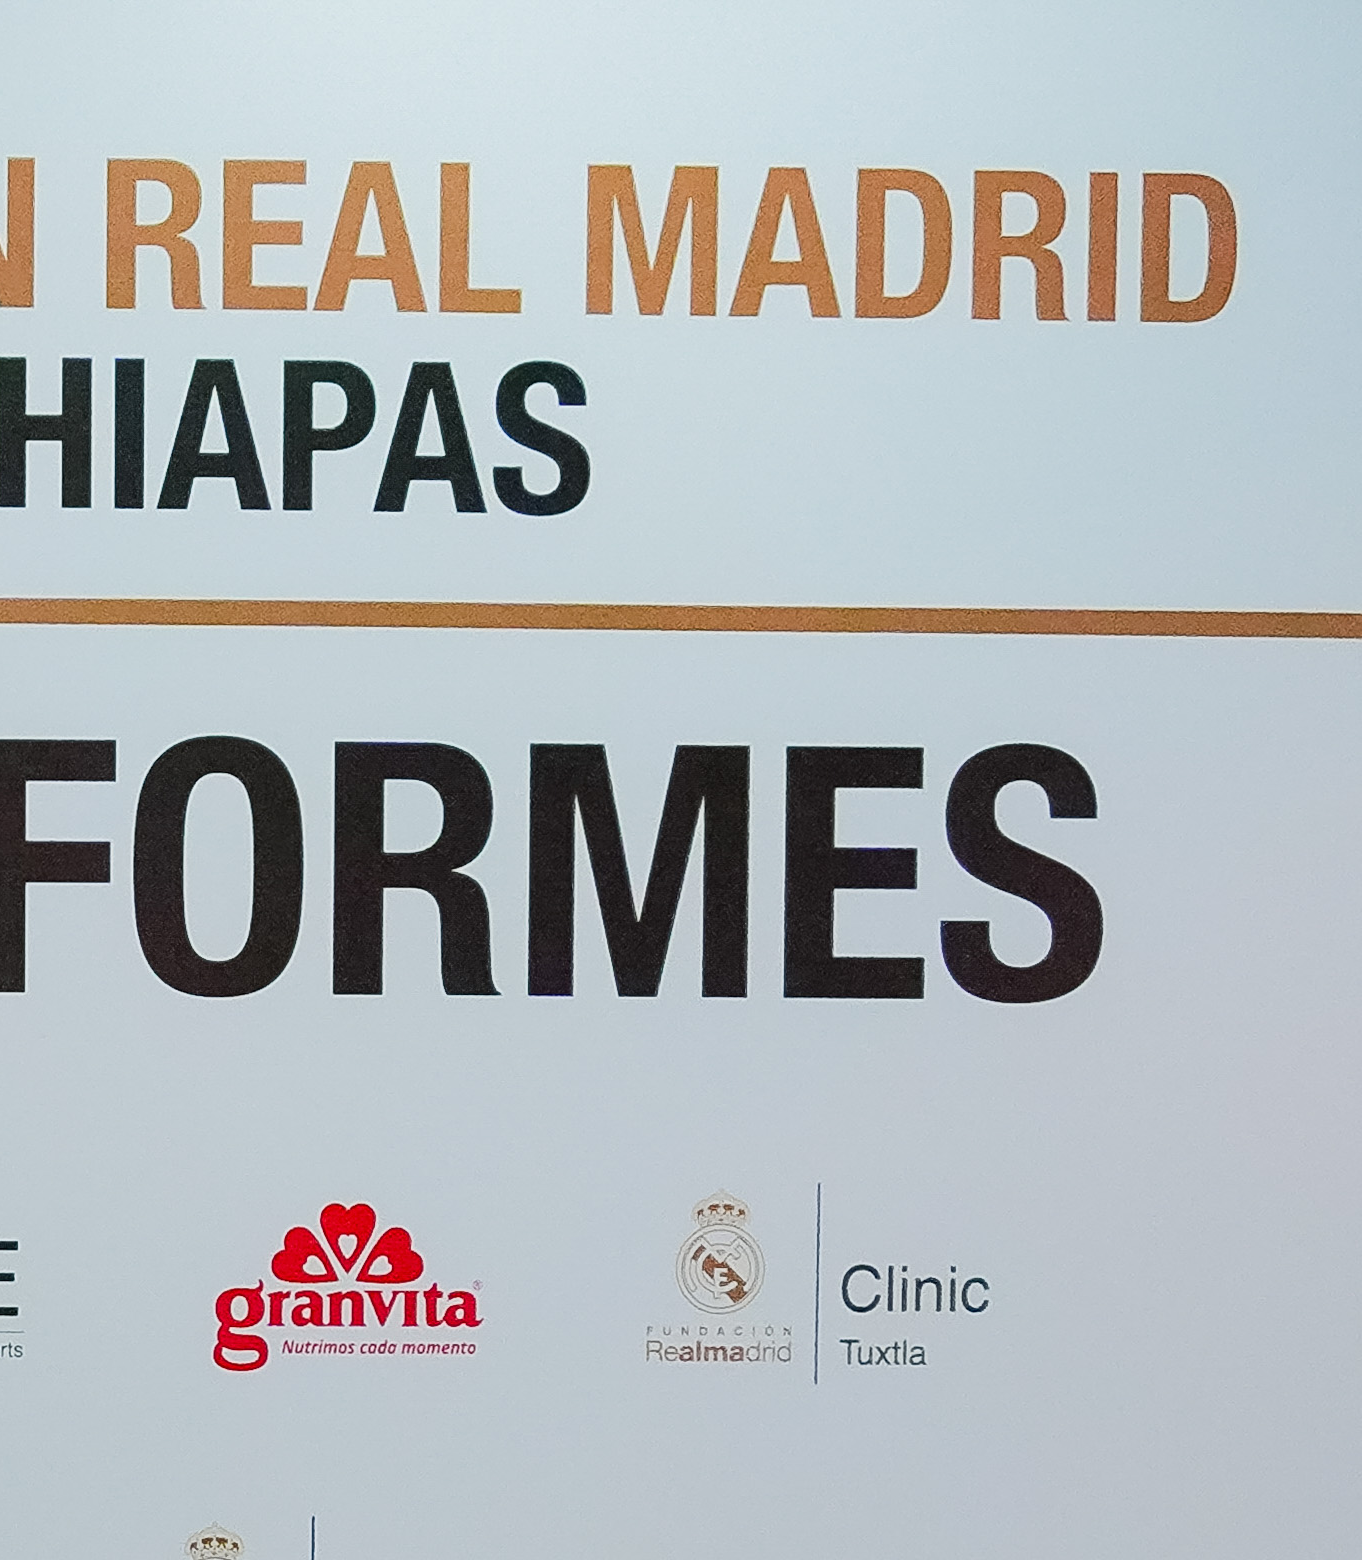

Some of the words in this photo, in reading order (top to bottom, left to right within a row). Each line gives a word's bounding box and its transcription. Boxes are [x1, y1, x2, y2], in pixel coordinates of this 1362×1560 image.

[106, 158, 522, 314] REAL
[586, 165, 1238, 323] MADRID
[842, 1265, 989, 1313] Clinic
[214, 1279, 484, 1371] granvita
[647, 1325, 792, 1337] FUNDACIÓN
[282, 1340, 355, 1354] Nutrimos
[360, 1340, 397, 1354] cada
[402, 1343, 476, 1354] momento
[647, 1341, 791, 1362] Realmadrid
[840, 1339, 926, 1365] Tuxtla
